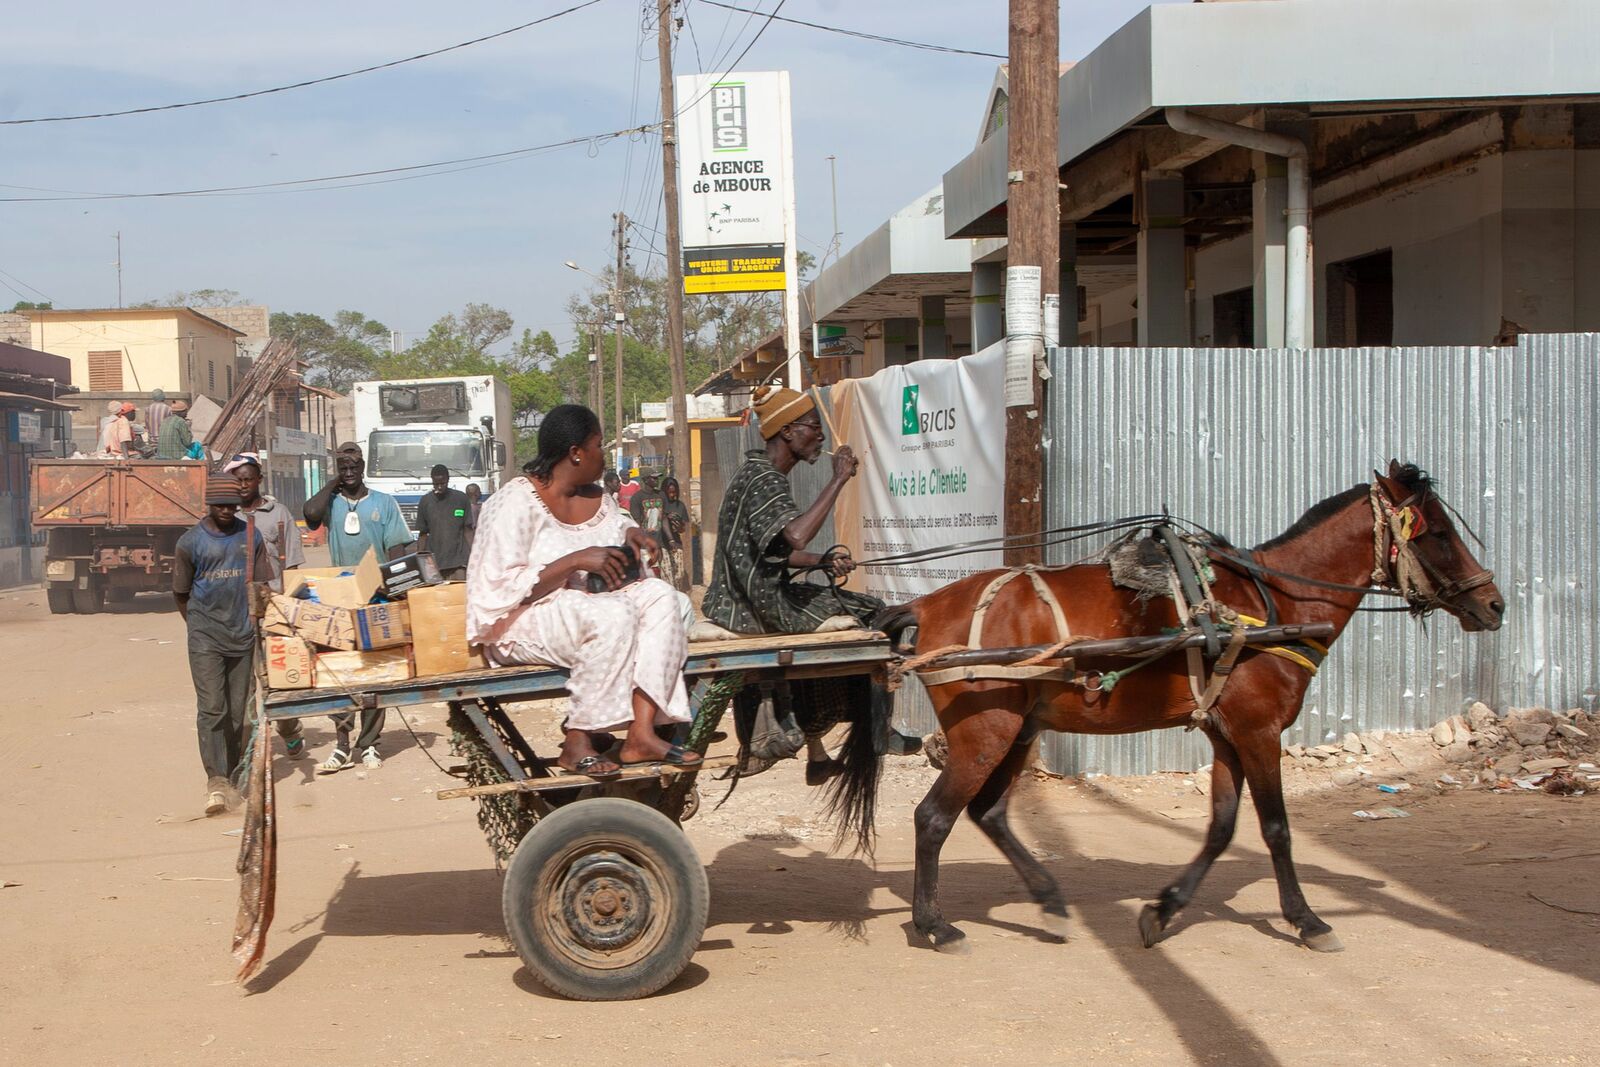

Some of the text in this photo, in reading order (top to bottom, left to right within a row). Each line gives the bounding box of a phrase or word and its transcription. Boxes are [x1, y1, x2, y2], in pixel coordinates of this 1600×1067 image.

[700, 160, 764, 175] AGENCE
[693, 178, 771, 193] de MBOUR
[688, 259, 728, 268] WESTERN
[920, 408, 956, 433] BICIS
[901, 444, 921, 454] Groupe
[930, 439, 954, 448] PARIBAS
[889, 466, 967, 496] Avis à la Clientèle
[959, 512, 972, 527] BICIS
